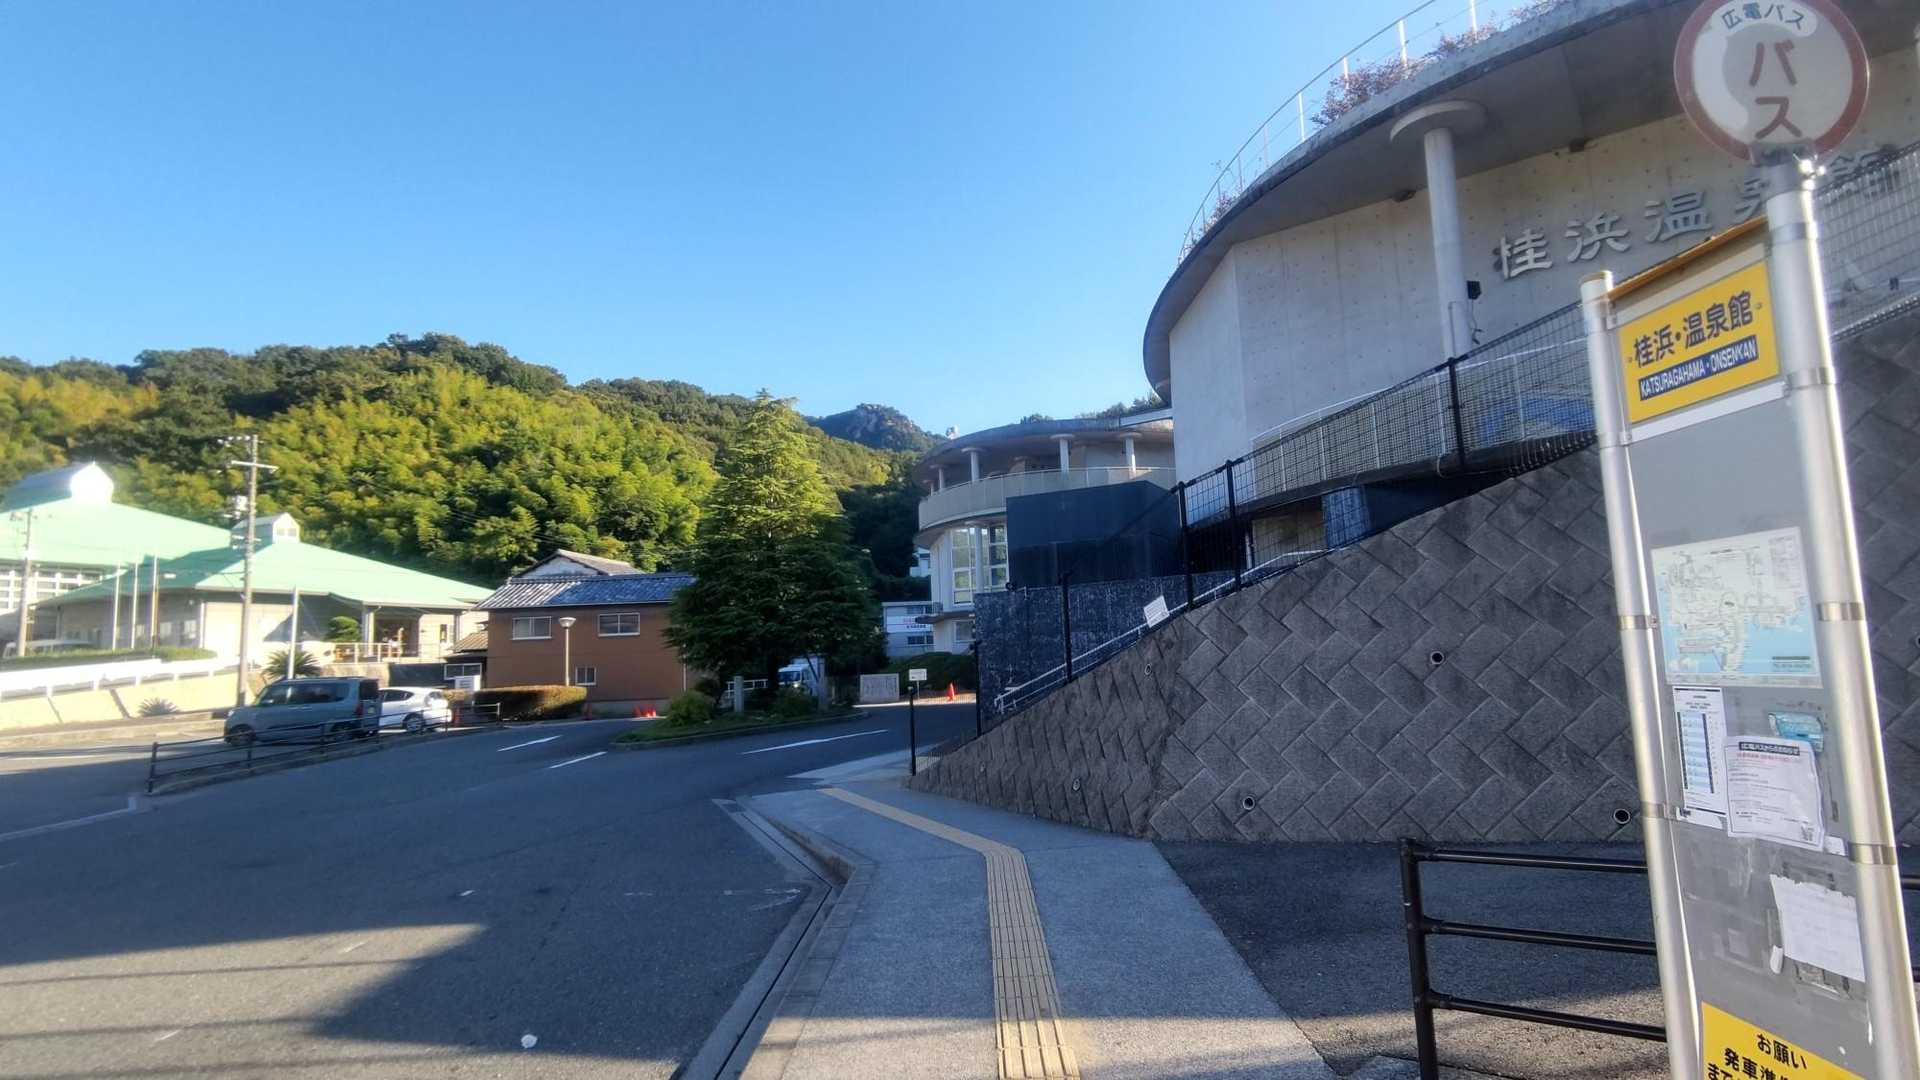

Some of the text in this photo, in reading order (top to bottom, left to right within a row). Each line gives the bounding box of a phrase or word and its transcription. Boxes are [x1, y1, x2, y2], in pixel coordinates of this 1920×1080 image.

[1722, 2, 1805, 30] 広電バス
[1749, 39, 1803, 141] バス
[1634, 290, 1754, 369] 桂浜・温泉館
[1723, 1047, 1790, 1080] 発車準
[1756, 1033, 1808, 1070] お願い
